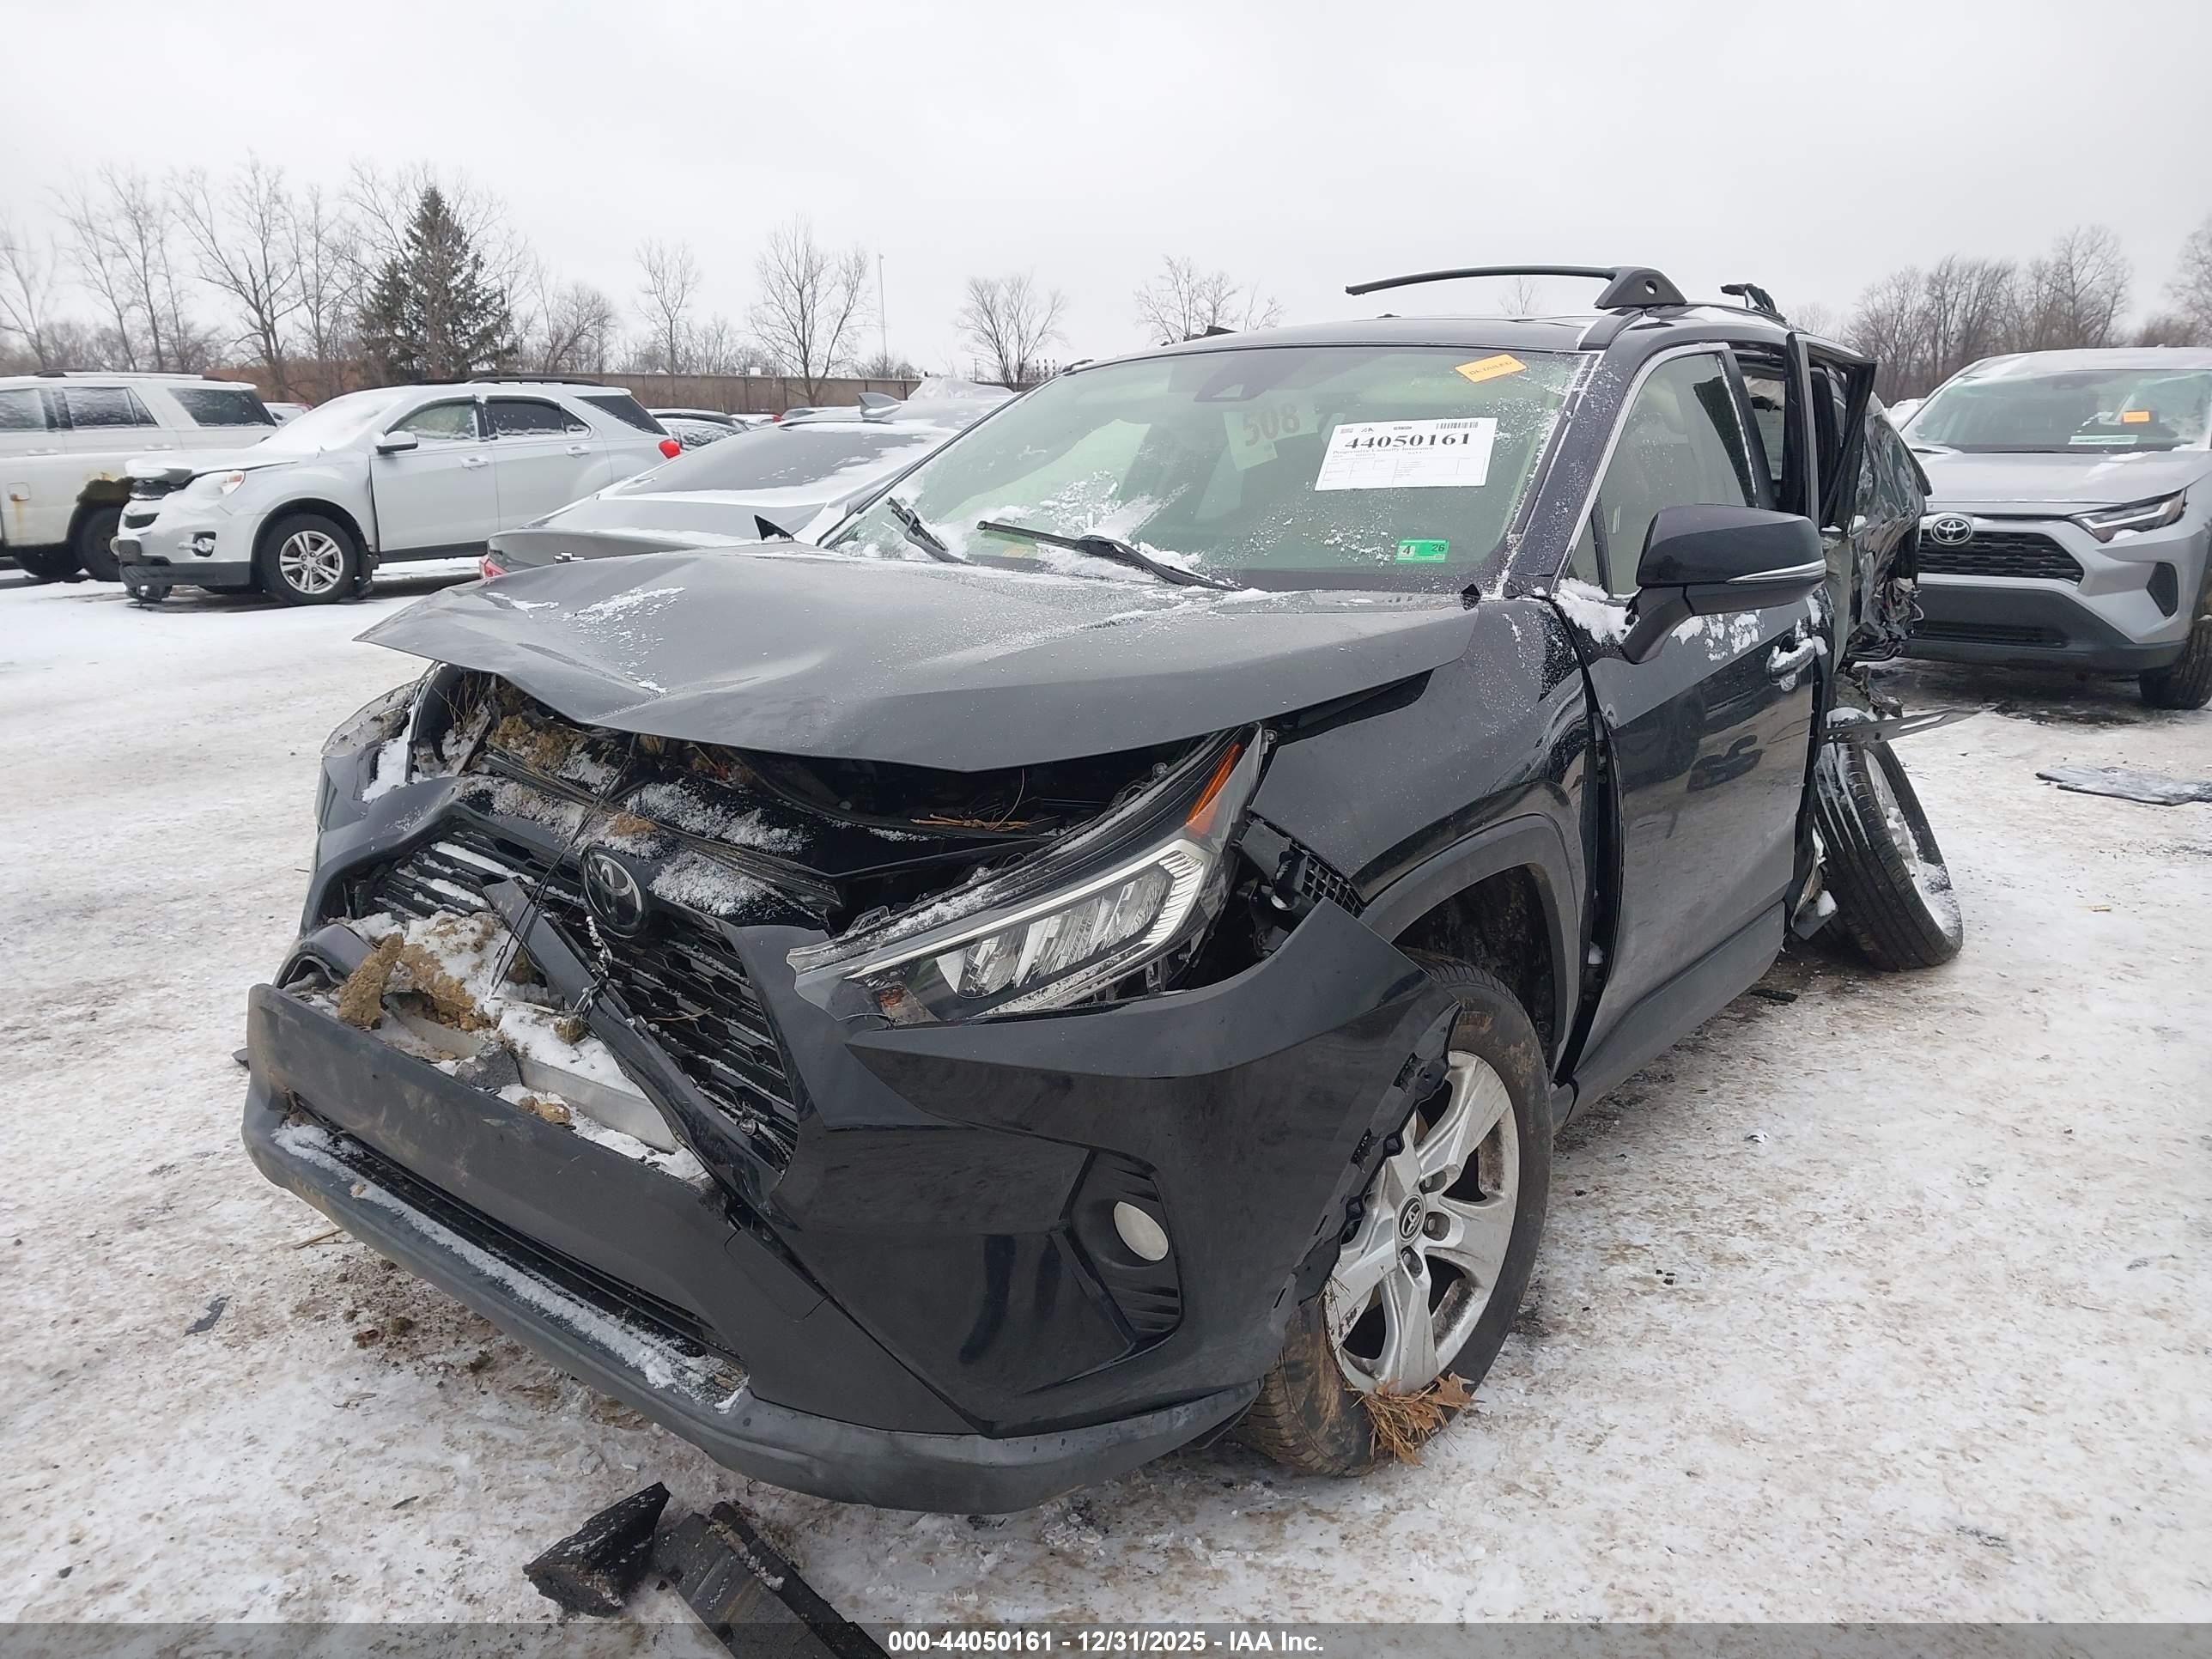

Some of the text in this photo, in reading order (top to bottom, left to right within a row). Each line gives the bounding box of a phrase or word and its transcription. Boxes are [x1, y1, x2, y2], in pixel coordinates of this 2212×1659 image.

[1243, 403, 1300, 447] 508
[1344, 433, 1469, 449] 44050161
[1402, 544, 1445, 555] 4 26
